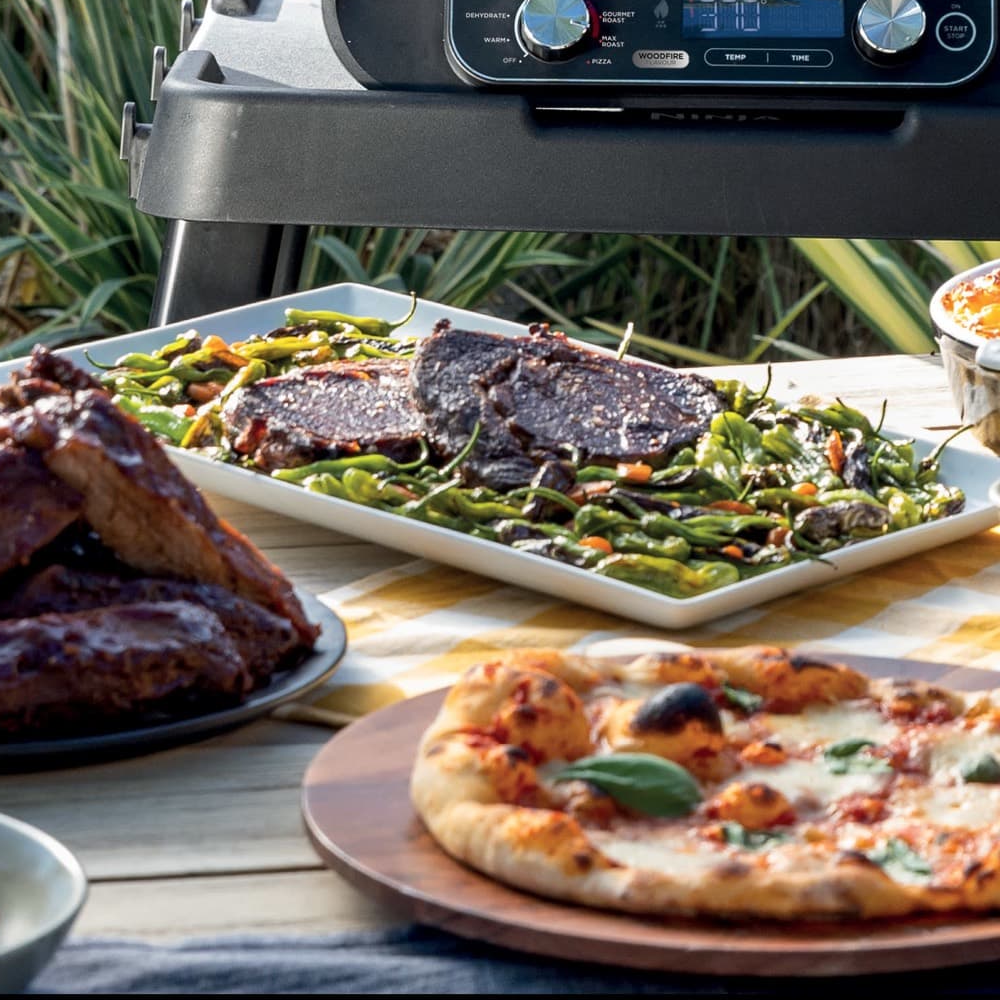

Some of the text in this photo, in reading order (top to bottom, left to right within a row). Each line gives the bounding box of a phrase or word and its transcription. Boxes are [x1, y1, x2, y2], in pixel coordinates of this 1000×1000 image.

[943, 25, 969, 33] START
[724, 53, 747, 61] TEMP
[791, 54, 810, 62] TIME
